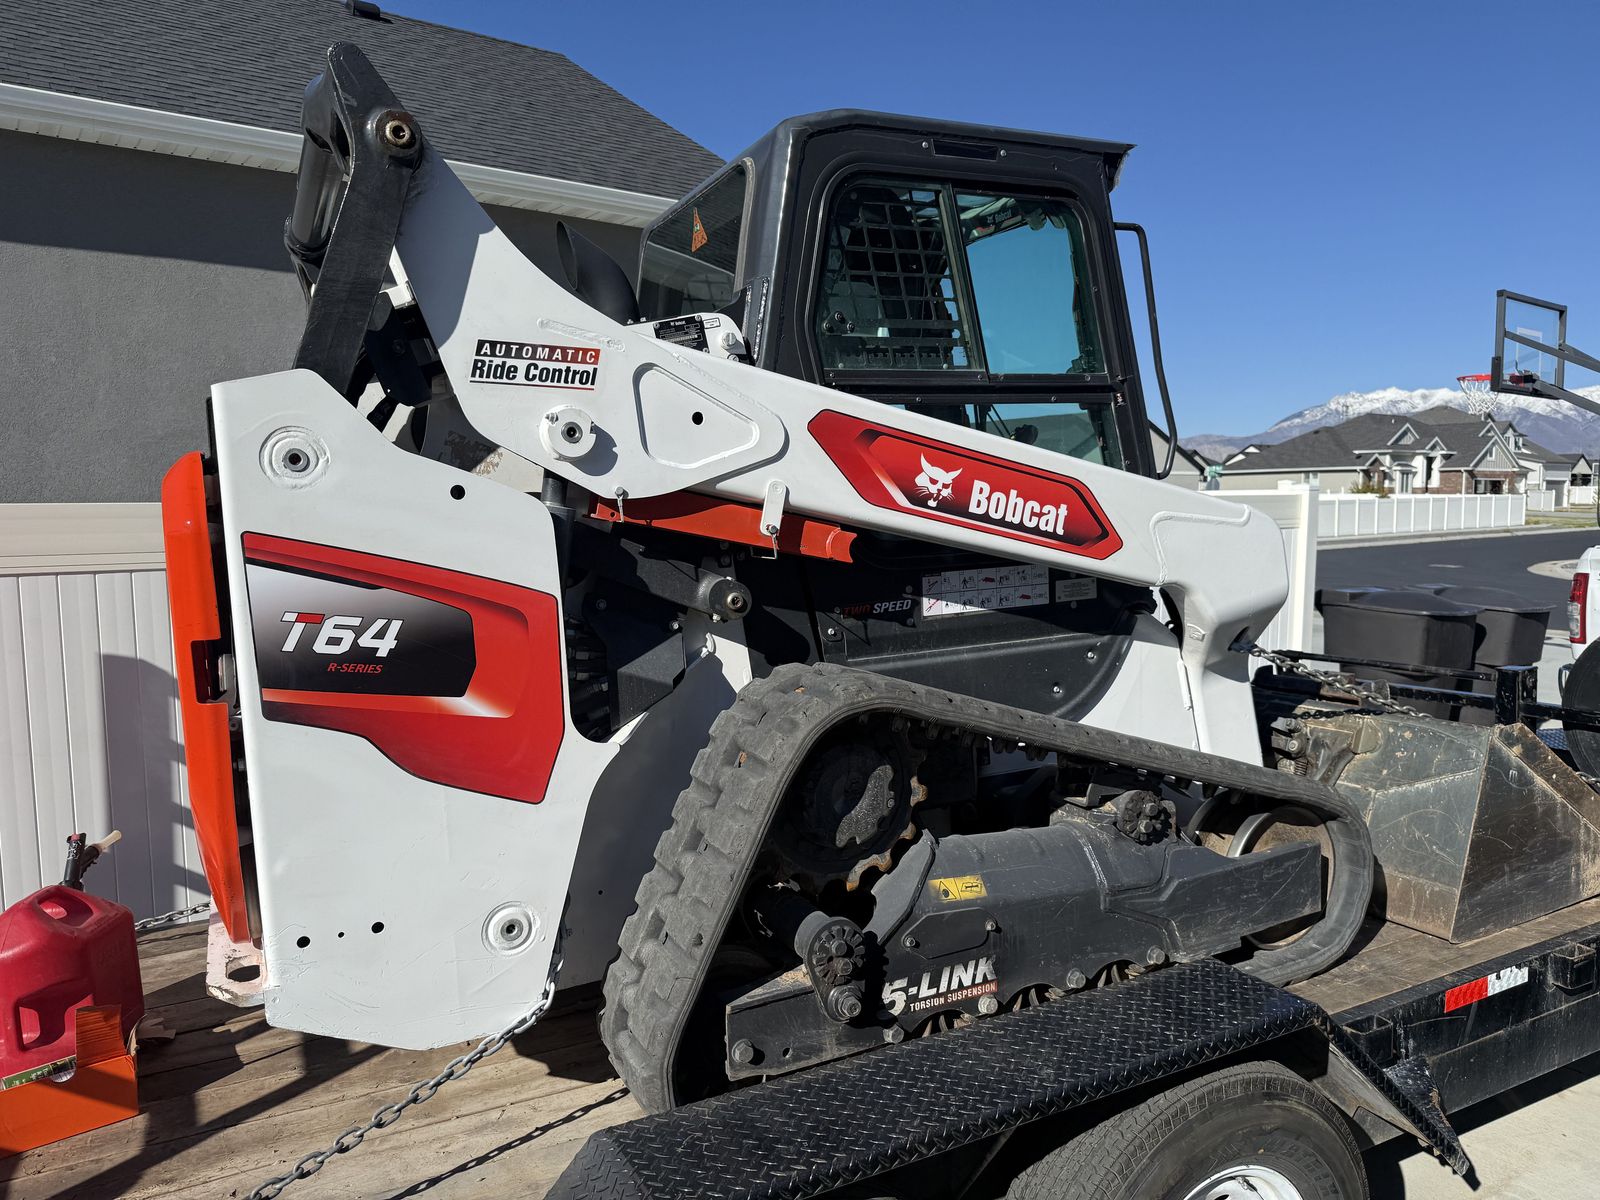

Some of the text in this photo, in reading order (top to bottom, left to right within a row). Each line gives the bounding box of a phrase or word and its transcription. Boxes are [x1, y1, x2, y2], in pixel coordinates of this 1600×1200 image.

[480, 343, 596, 363] AUTOMATIC
[470, 359, 598, 386] Ride Control
[968, 479, 1068, 536] Bobcat
[872, 599, 912, 614] SPEED
[280, 611, 404, 657] T64
[327, 662, 383, 674] R-SERIES
[881, 955, 998, 1016] 5-LINK
[909, 981, 997, 1012] TORSION SUSPENSION
